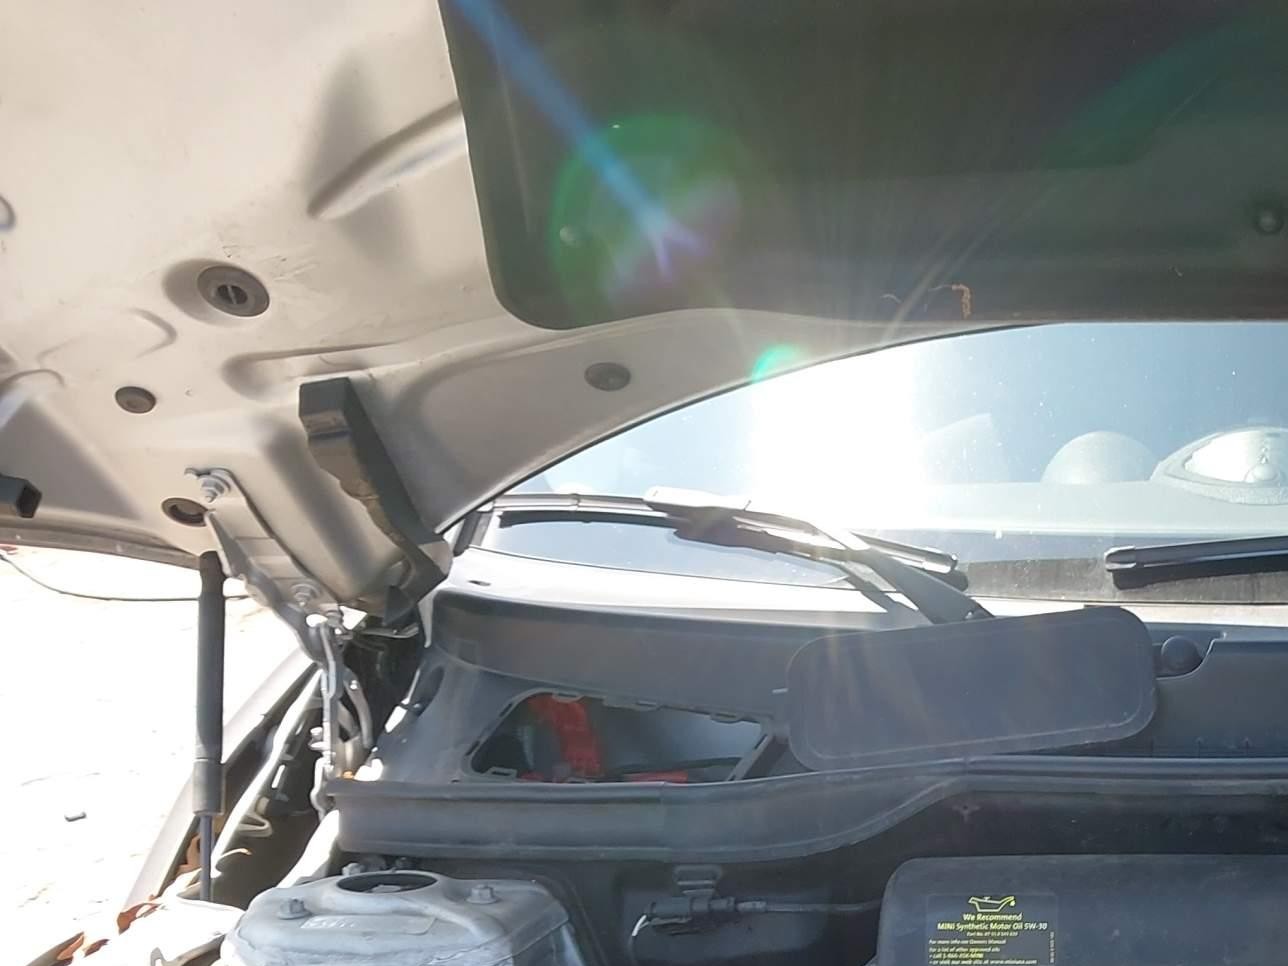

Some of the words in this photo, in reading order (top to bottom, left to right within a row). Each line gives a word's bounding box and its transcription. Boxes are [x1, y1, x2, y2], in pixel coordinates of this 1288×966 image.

[962, 913, 976, 921] We
[976, 912, 1022, 921] Recommend
[937, 922, 955, 930] MINI
[956, 922, 989, 932] Synthetic
[989, 922, 1011, 930] Motor
[1012, 922, 1023, 930] Oil
[1024, 922, 1048, 930] 5W-30
